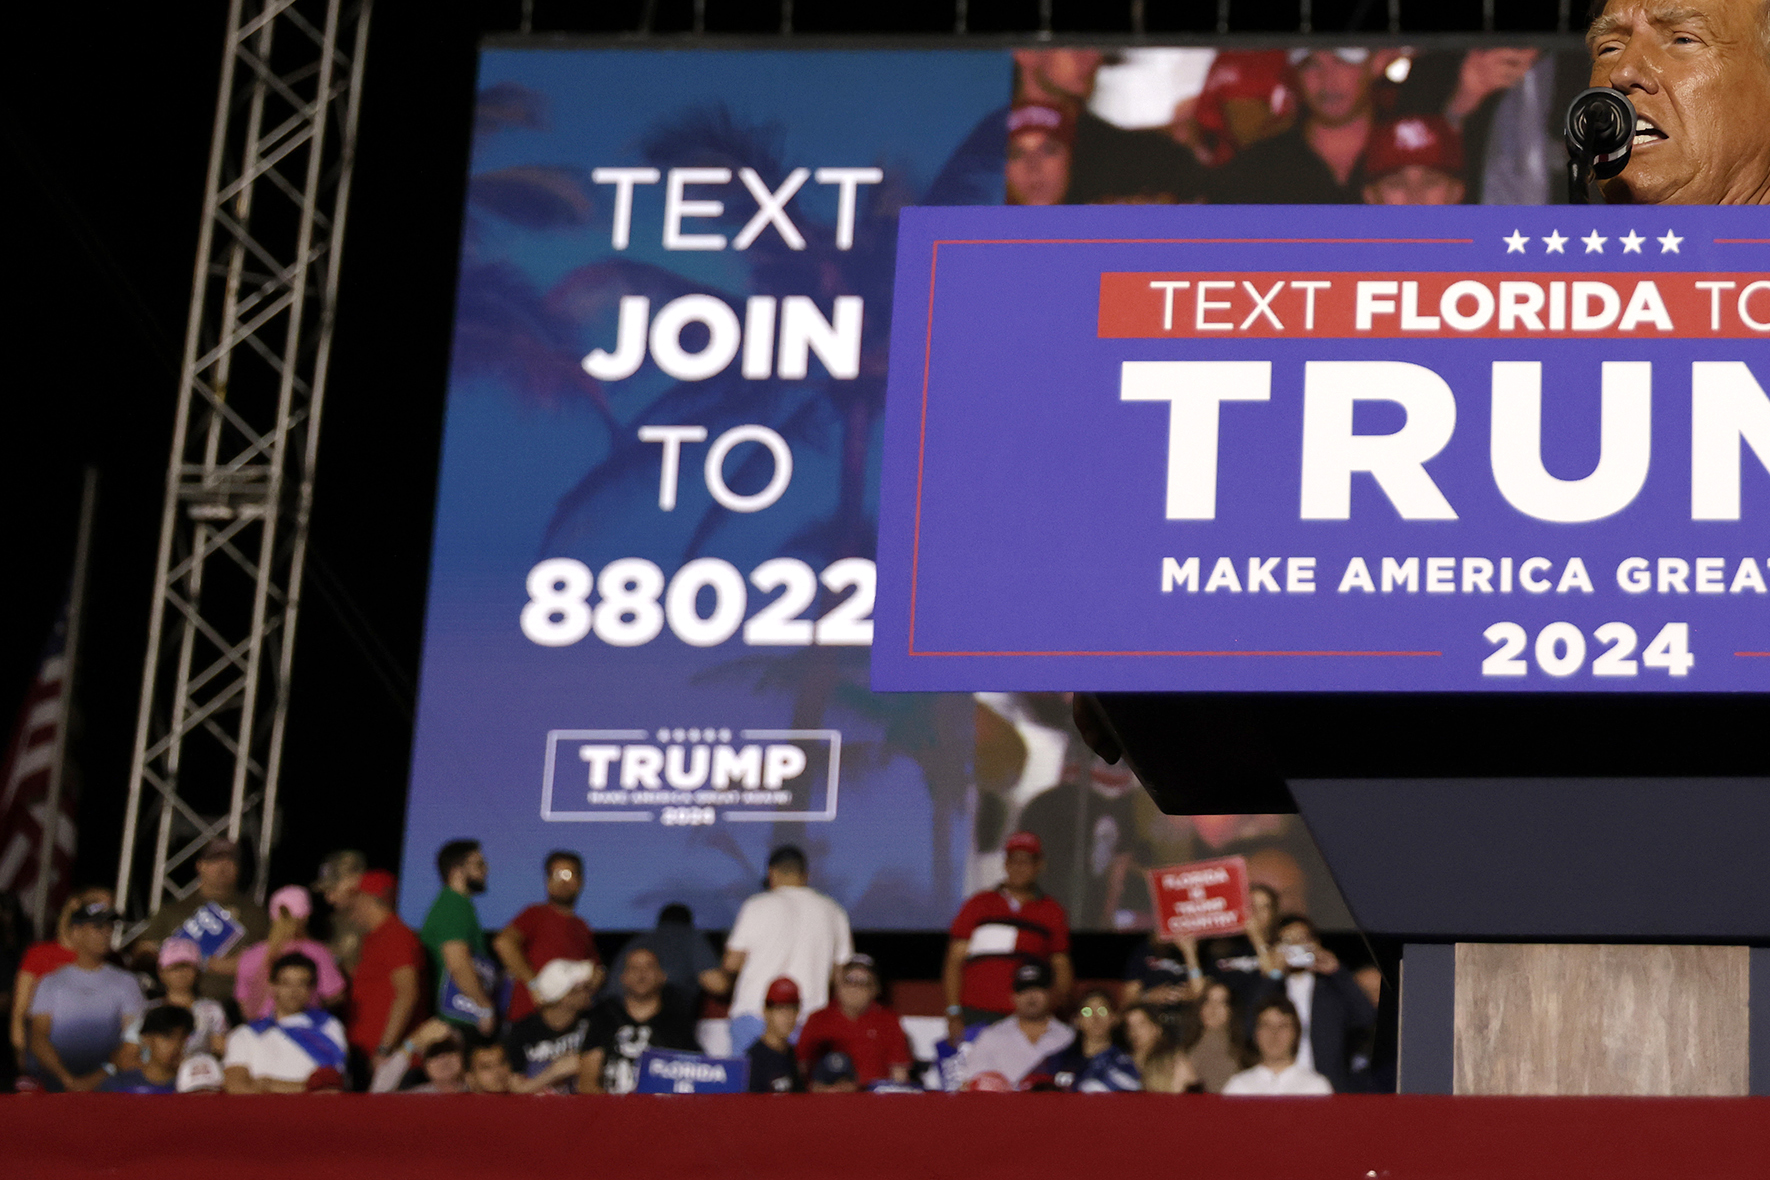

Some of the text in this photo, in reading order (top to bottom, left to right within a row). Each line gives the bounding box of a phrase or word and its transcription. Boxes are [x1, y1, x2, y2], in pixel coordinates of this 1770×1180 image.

[592, 167, 883, 251] TEXT
[581, 293, 864, 381] JOIN
[1149, 280, 1332, 331] TEXT
[1355, 280, 1674, 332] FLORIDA
[637, 424, 794, 513] TO
[519, 557, 877, 647] 88022
[1160, 556, 1317, 594] MAKE
[1337, 556, 1595, 594] AMERICA
[1481, 621, 1695, 678] 2024
[579, 744, 807, 790] TRUMP
